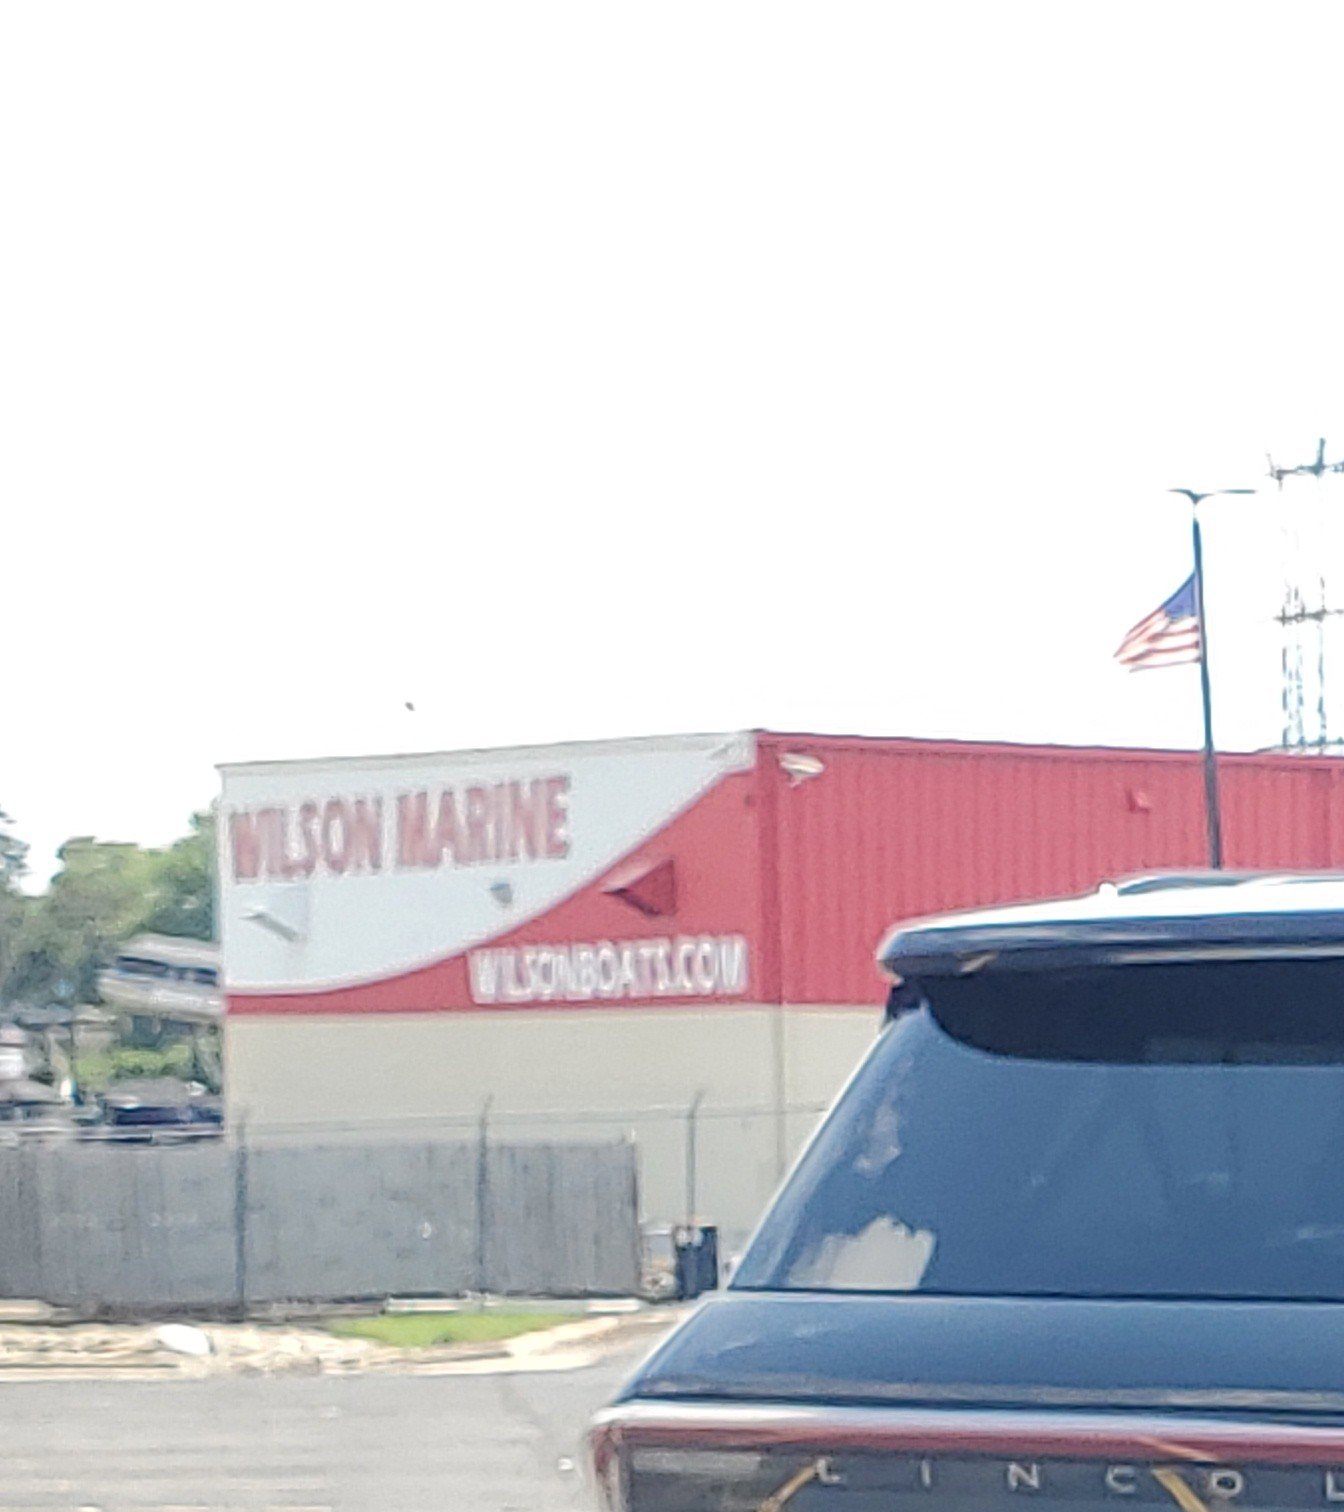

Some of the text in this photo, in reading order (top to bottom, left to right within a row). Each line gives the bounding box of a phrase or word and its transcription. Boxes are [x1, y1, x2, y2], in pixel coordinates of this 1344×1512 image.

[230, 775, 571, 882] WILSON MARINE
[467, 935, 747, 1003] WILSONBOATS.COM
